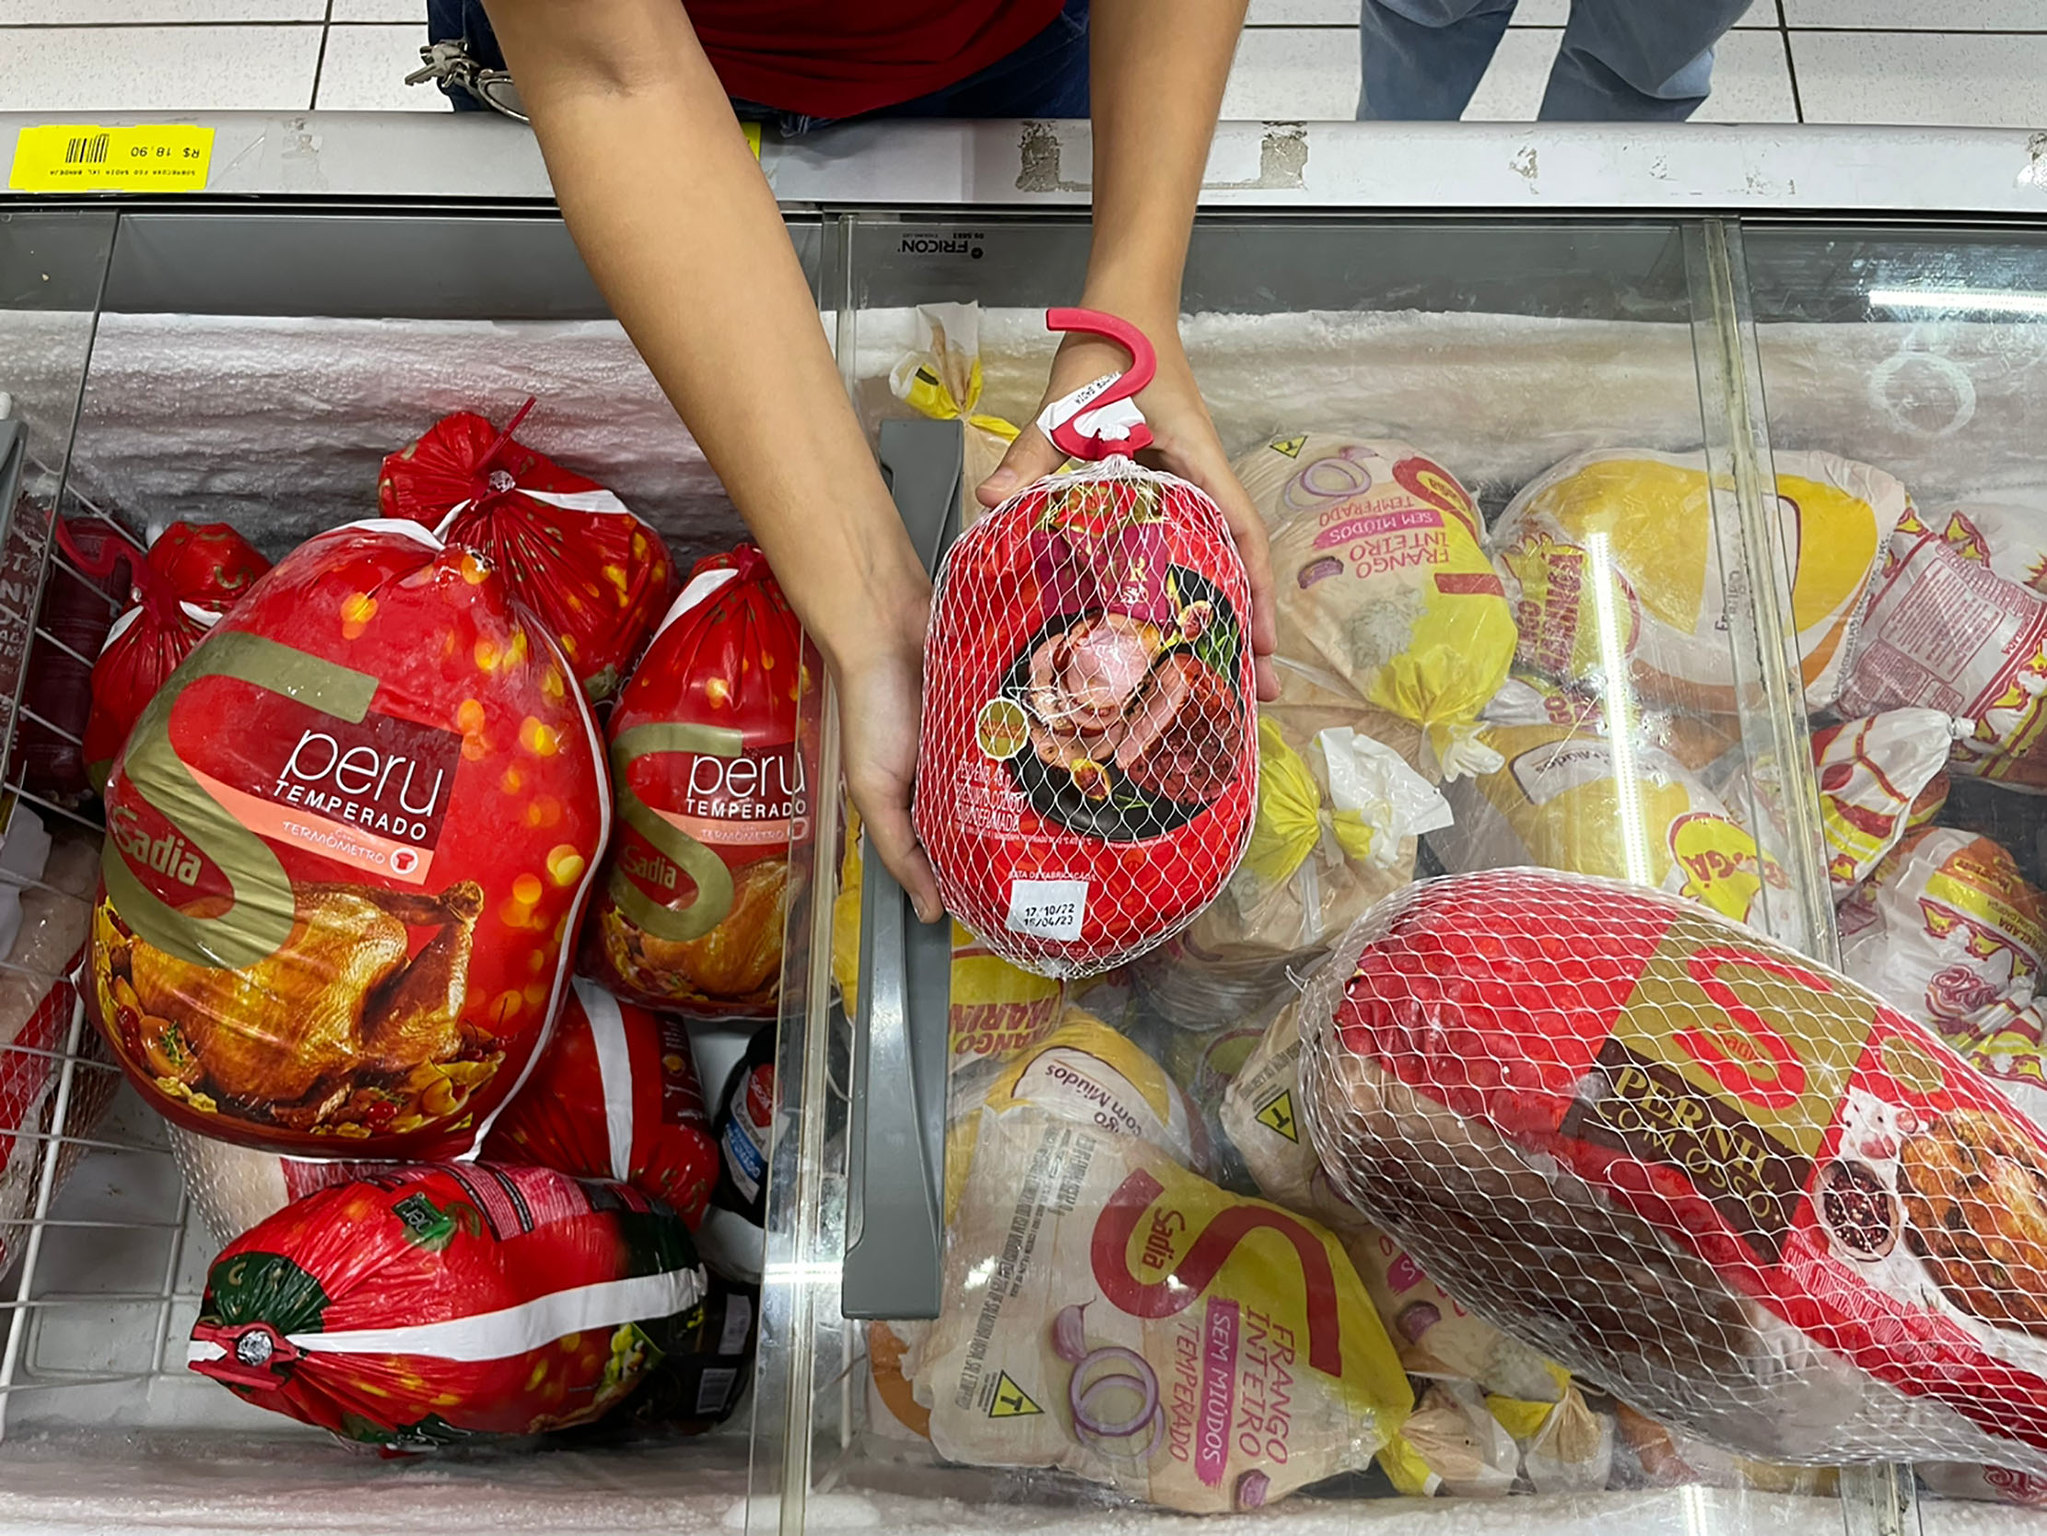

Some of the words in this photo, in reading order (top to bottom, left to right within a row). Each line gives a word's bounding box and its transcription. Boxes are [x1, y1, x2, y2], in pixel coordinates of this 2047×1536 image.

[182, 147, 201, 159] R$
[902, 239, 969, 254] FRICON
[1317, 496, 1416, 527] TEMPERADO
[1328, 515, 1388, 544] MIÚDOS
[1390, 511, 1435, 528] SEM
[1349, 530, 1449, 562] INTEIRO
[1355, 548, 1450, 580] FRANGO
[279, 727, 444, 818] peru
[687, 752, 806, 798] peru
[272, 779, 429, 842] TEMPERADO
[685, 798, 807, 820] TEMPERADO
[110, 804, 203, 887] Sadia
[283, 820, 388, 865] TERMÔMETRO
[621, 844, 678, 891] Sadia
[1044, 1064, 1112, 1108] Miúdos
[1610, 1060, 1778, 1193] PERNIL
[1596, 1096, 1678, 1159] COM
[1681, 1138, 1774, 1221] OSSO
[1139, 1205, 1186, 1272] Sadia
[1211, 1312, 1234, 1358] SEM
[1169, 1319, 1201, 1465] TEMPERADO
[1239, 1309, 1270, 1459] INTEIRO
[1264, 1322, 1297, 1466] FRANGO
[1201, 1366, 1232, 1464] MIÚDOS
